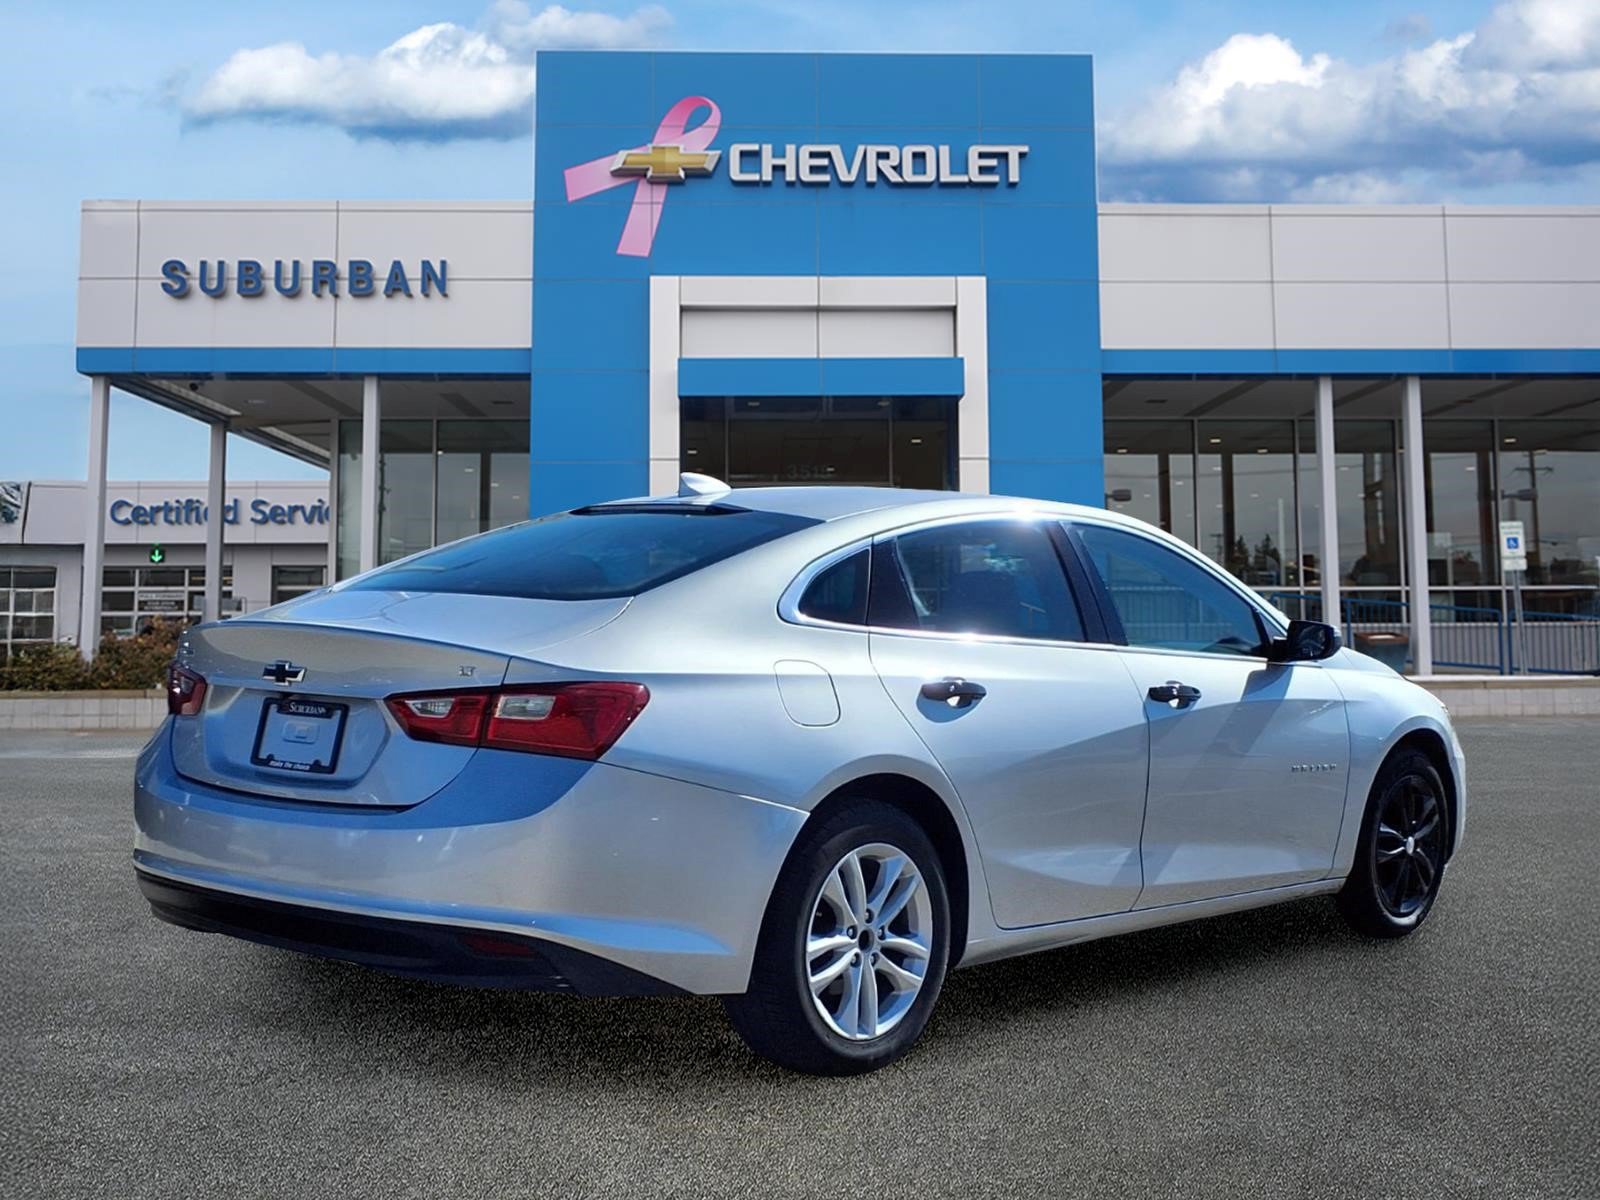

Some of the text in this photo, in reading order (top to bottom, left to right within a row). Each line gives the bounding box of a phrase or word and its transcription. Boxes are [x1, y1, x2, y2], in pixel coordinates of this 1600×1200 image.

[729, 143, 1029, 184] CHEVROLET
[160, 259, 448, 299] SUBURBAN
[110, 498, 241, 526] Certifid
